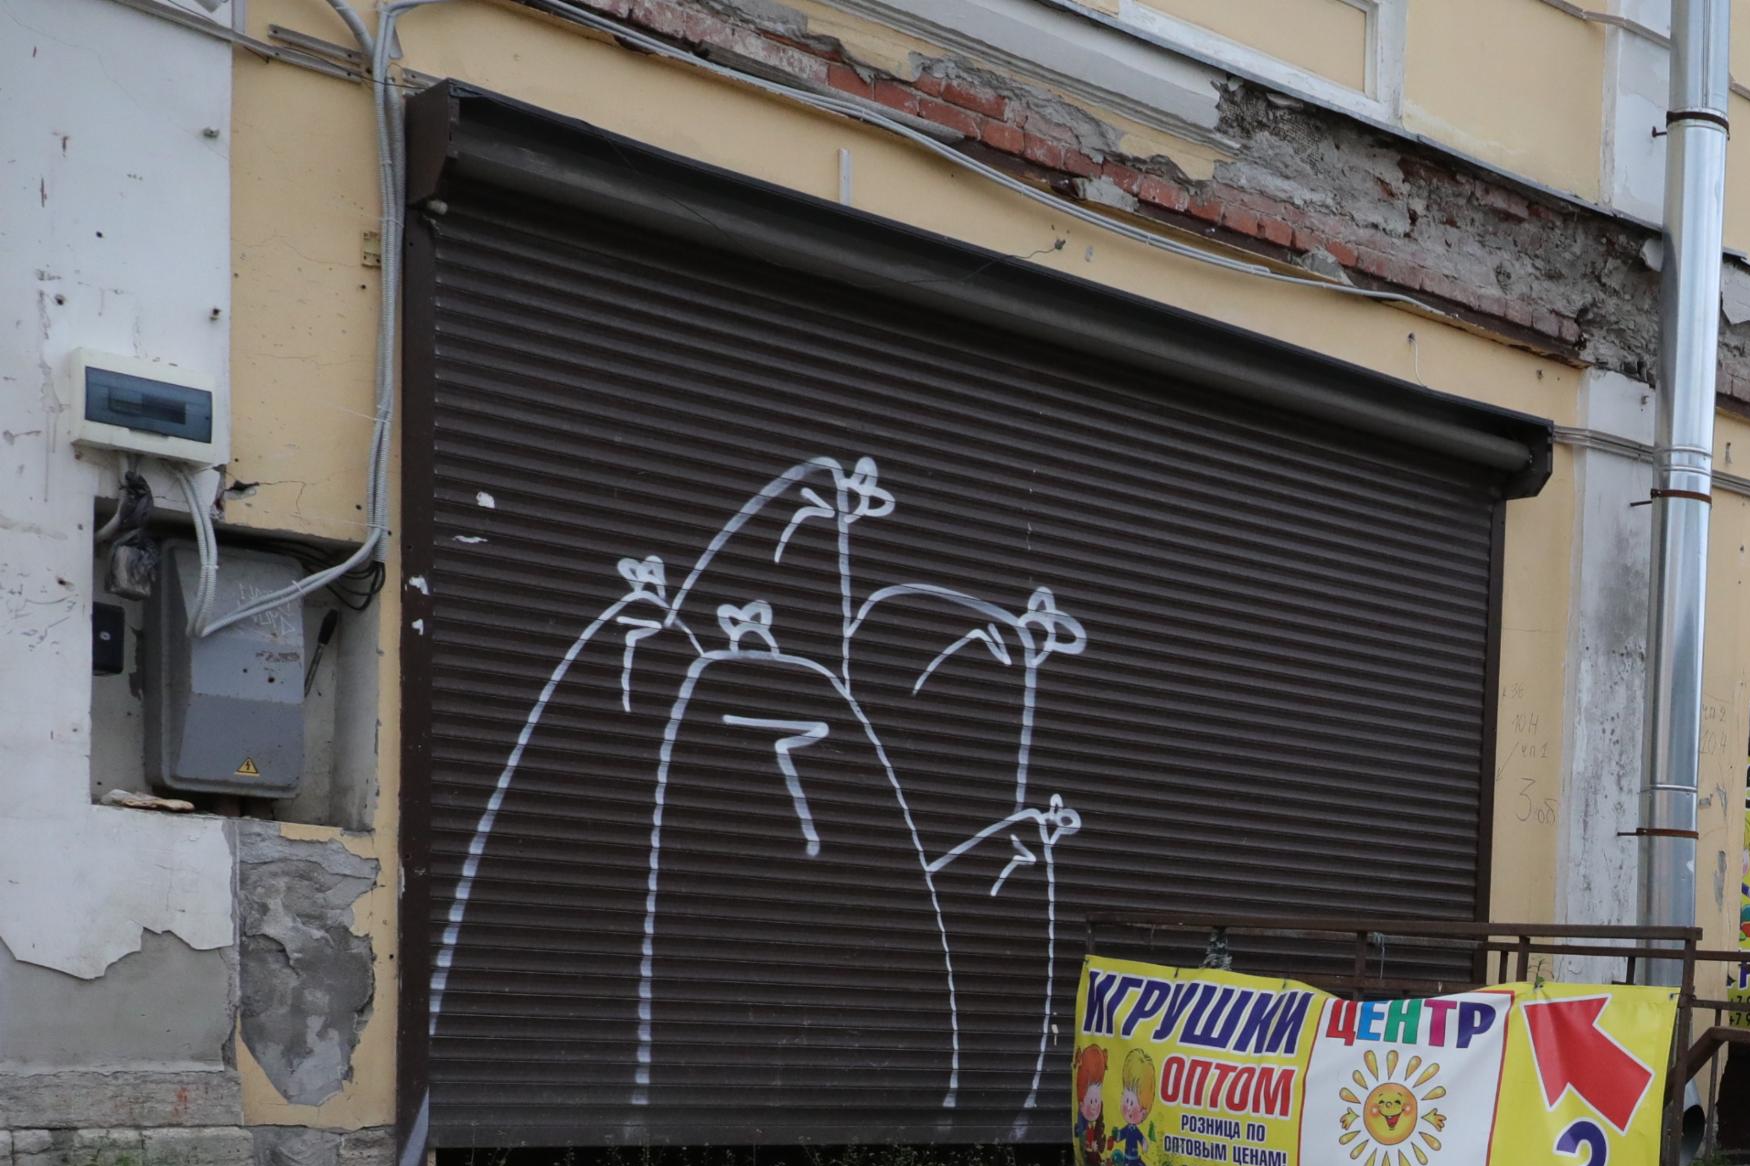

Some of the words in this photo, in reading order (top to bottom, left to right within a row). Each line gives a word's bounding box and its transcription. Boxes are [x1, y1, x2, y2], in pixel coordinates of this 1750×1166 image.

[1084, 970, 1314, 1054] ИГРУШКИ
[1326, 999, 1497, 1048] ЦЕНТР
[1160, 1056, 1296, 1117] ОПТОМ
[1164, 1135, 1227, 1161] ОПТОВЫМ
[1181, 1114, 1241, 1140] РОЗНИЦА
[1246, 1123, 1266, 1142] ПО
